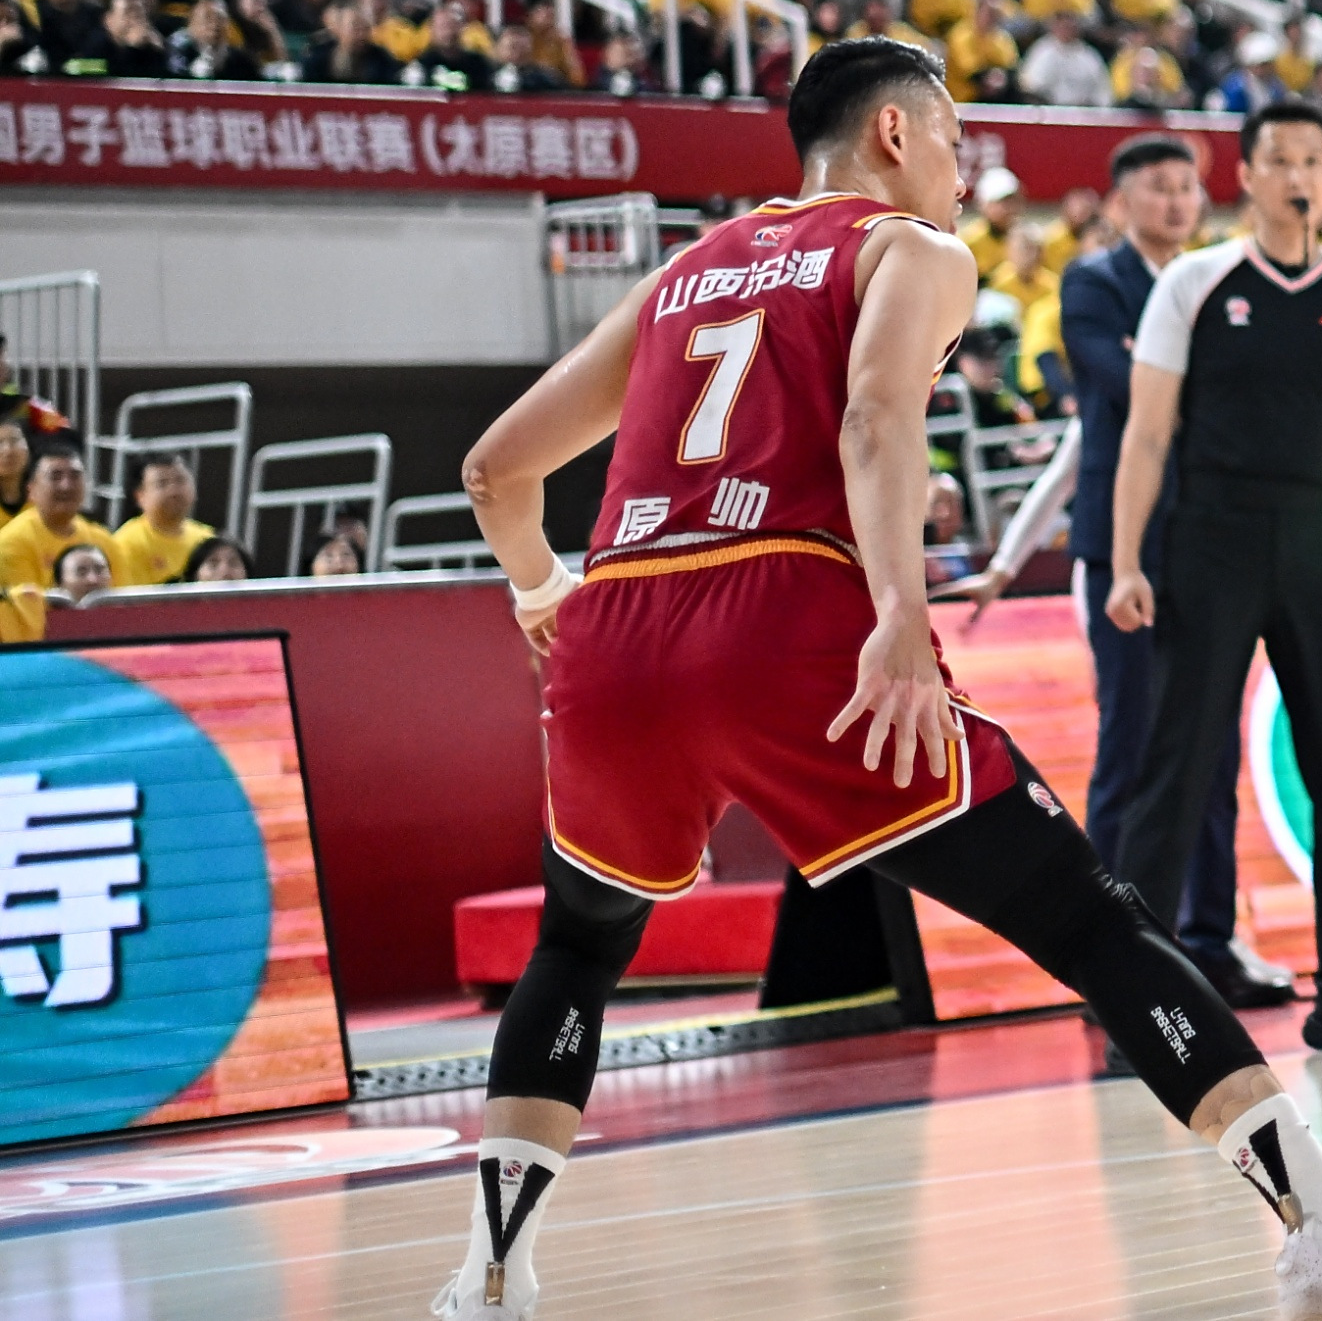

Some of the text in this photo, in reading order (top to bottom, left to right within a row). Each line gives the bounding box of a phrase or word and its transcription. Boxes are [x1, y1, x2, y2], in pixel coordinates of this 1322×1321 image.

[655, 246, 834, 324] 山西汾酒
[676, 309, 765, 465] 7
[1150, 1005, 1191, 1064] BASKETBALL
